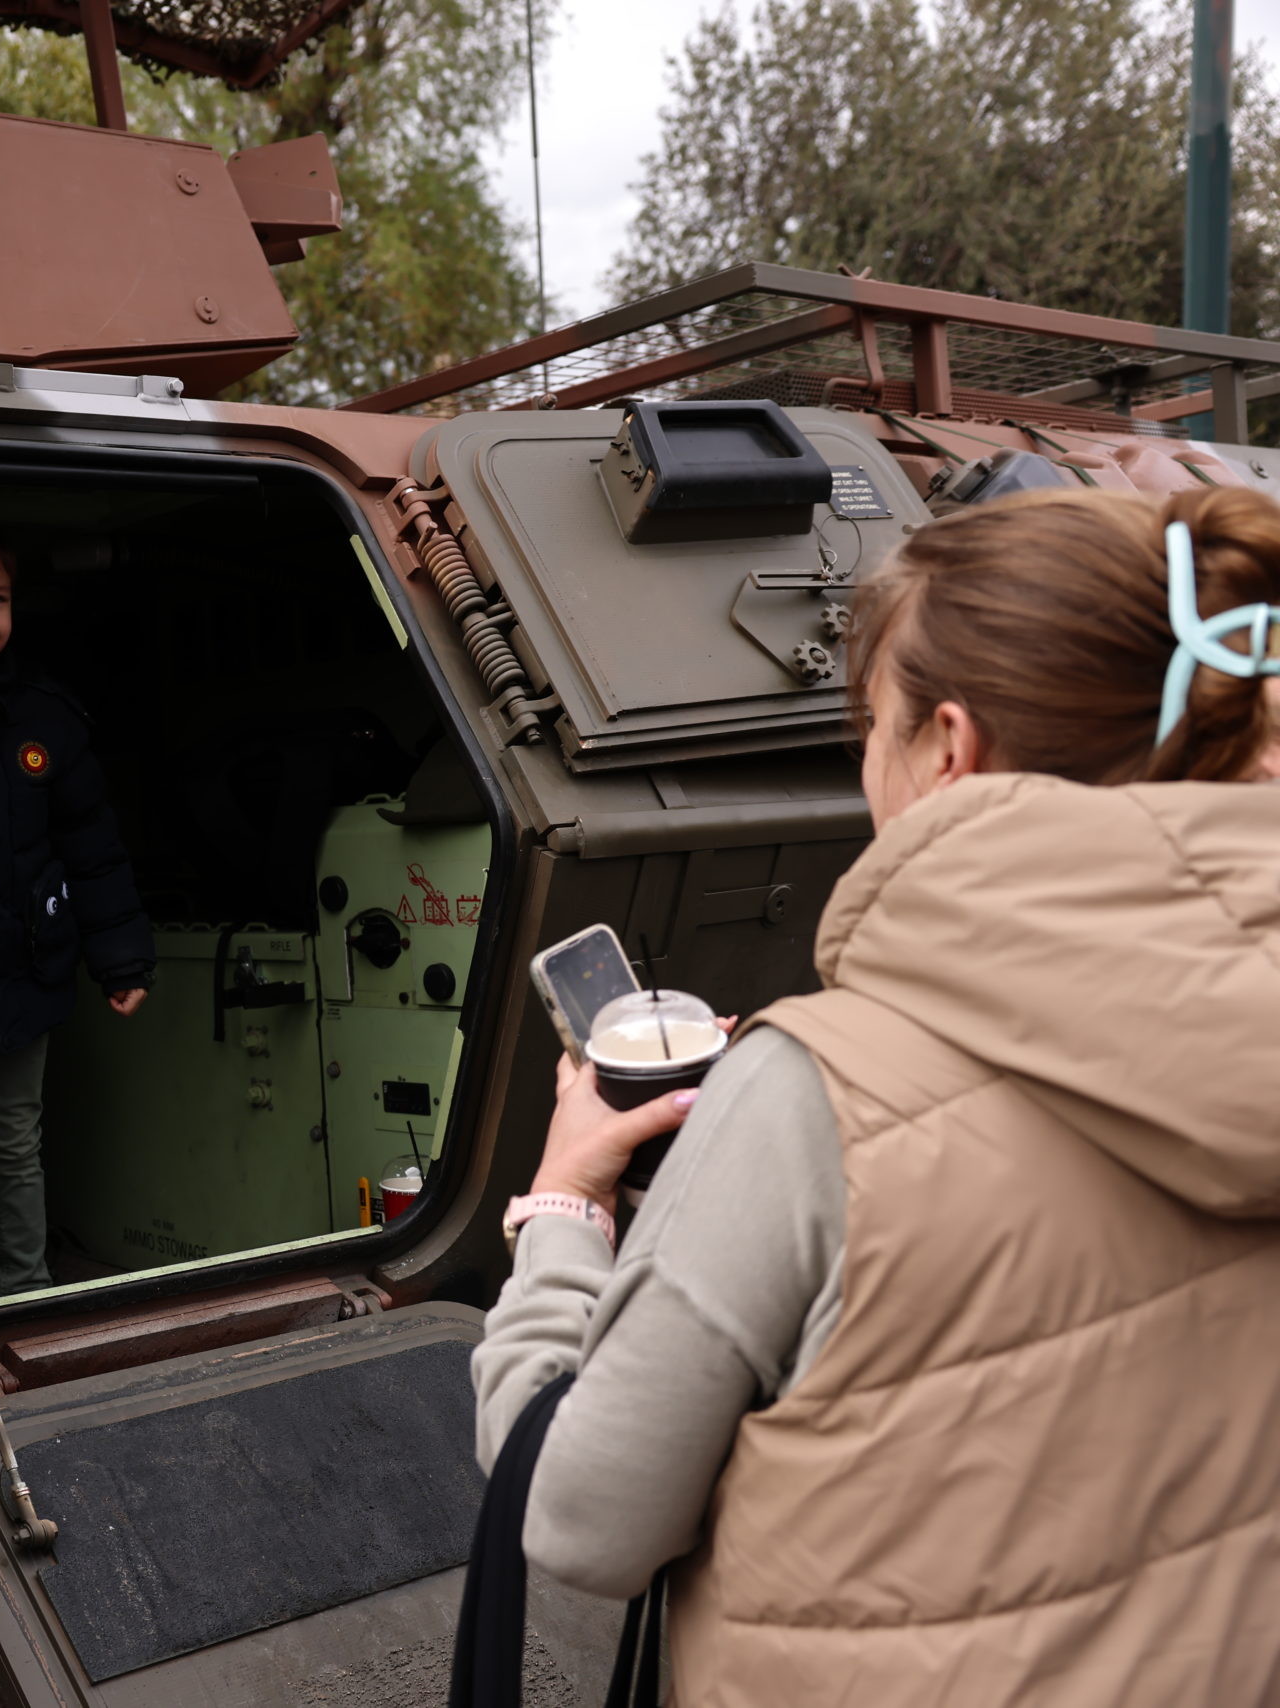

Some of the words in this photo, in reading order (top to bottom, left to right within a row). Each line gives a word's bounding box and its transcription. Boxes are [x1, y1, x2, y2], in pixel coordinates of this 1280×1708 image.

[270, 940, 291, 953] RIFLE
[123, 1224, 156, 1251] AMMO
[158, 1234, 208, 1260] STOWAGE
